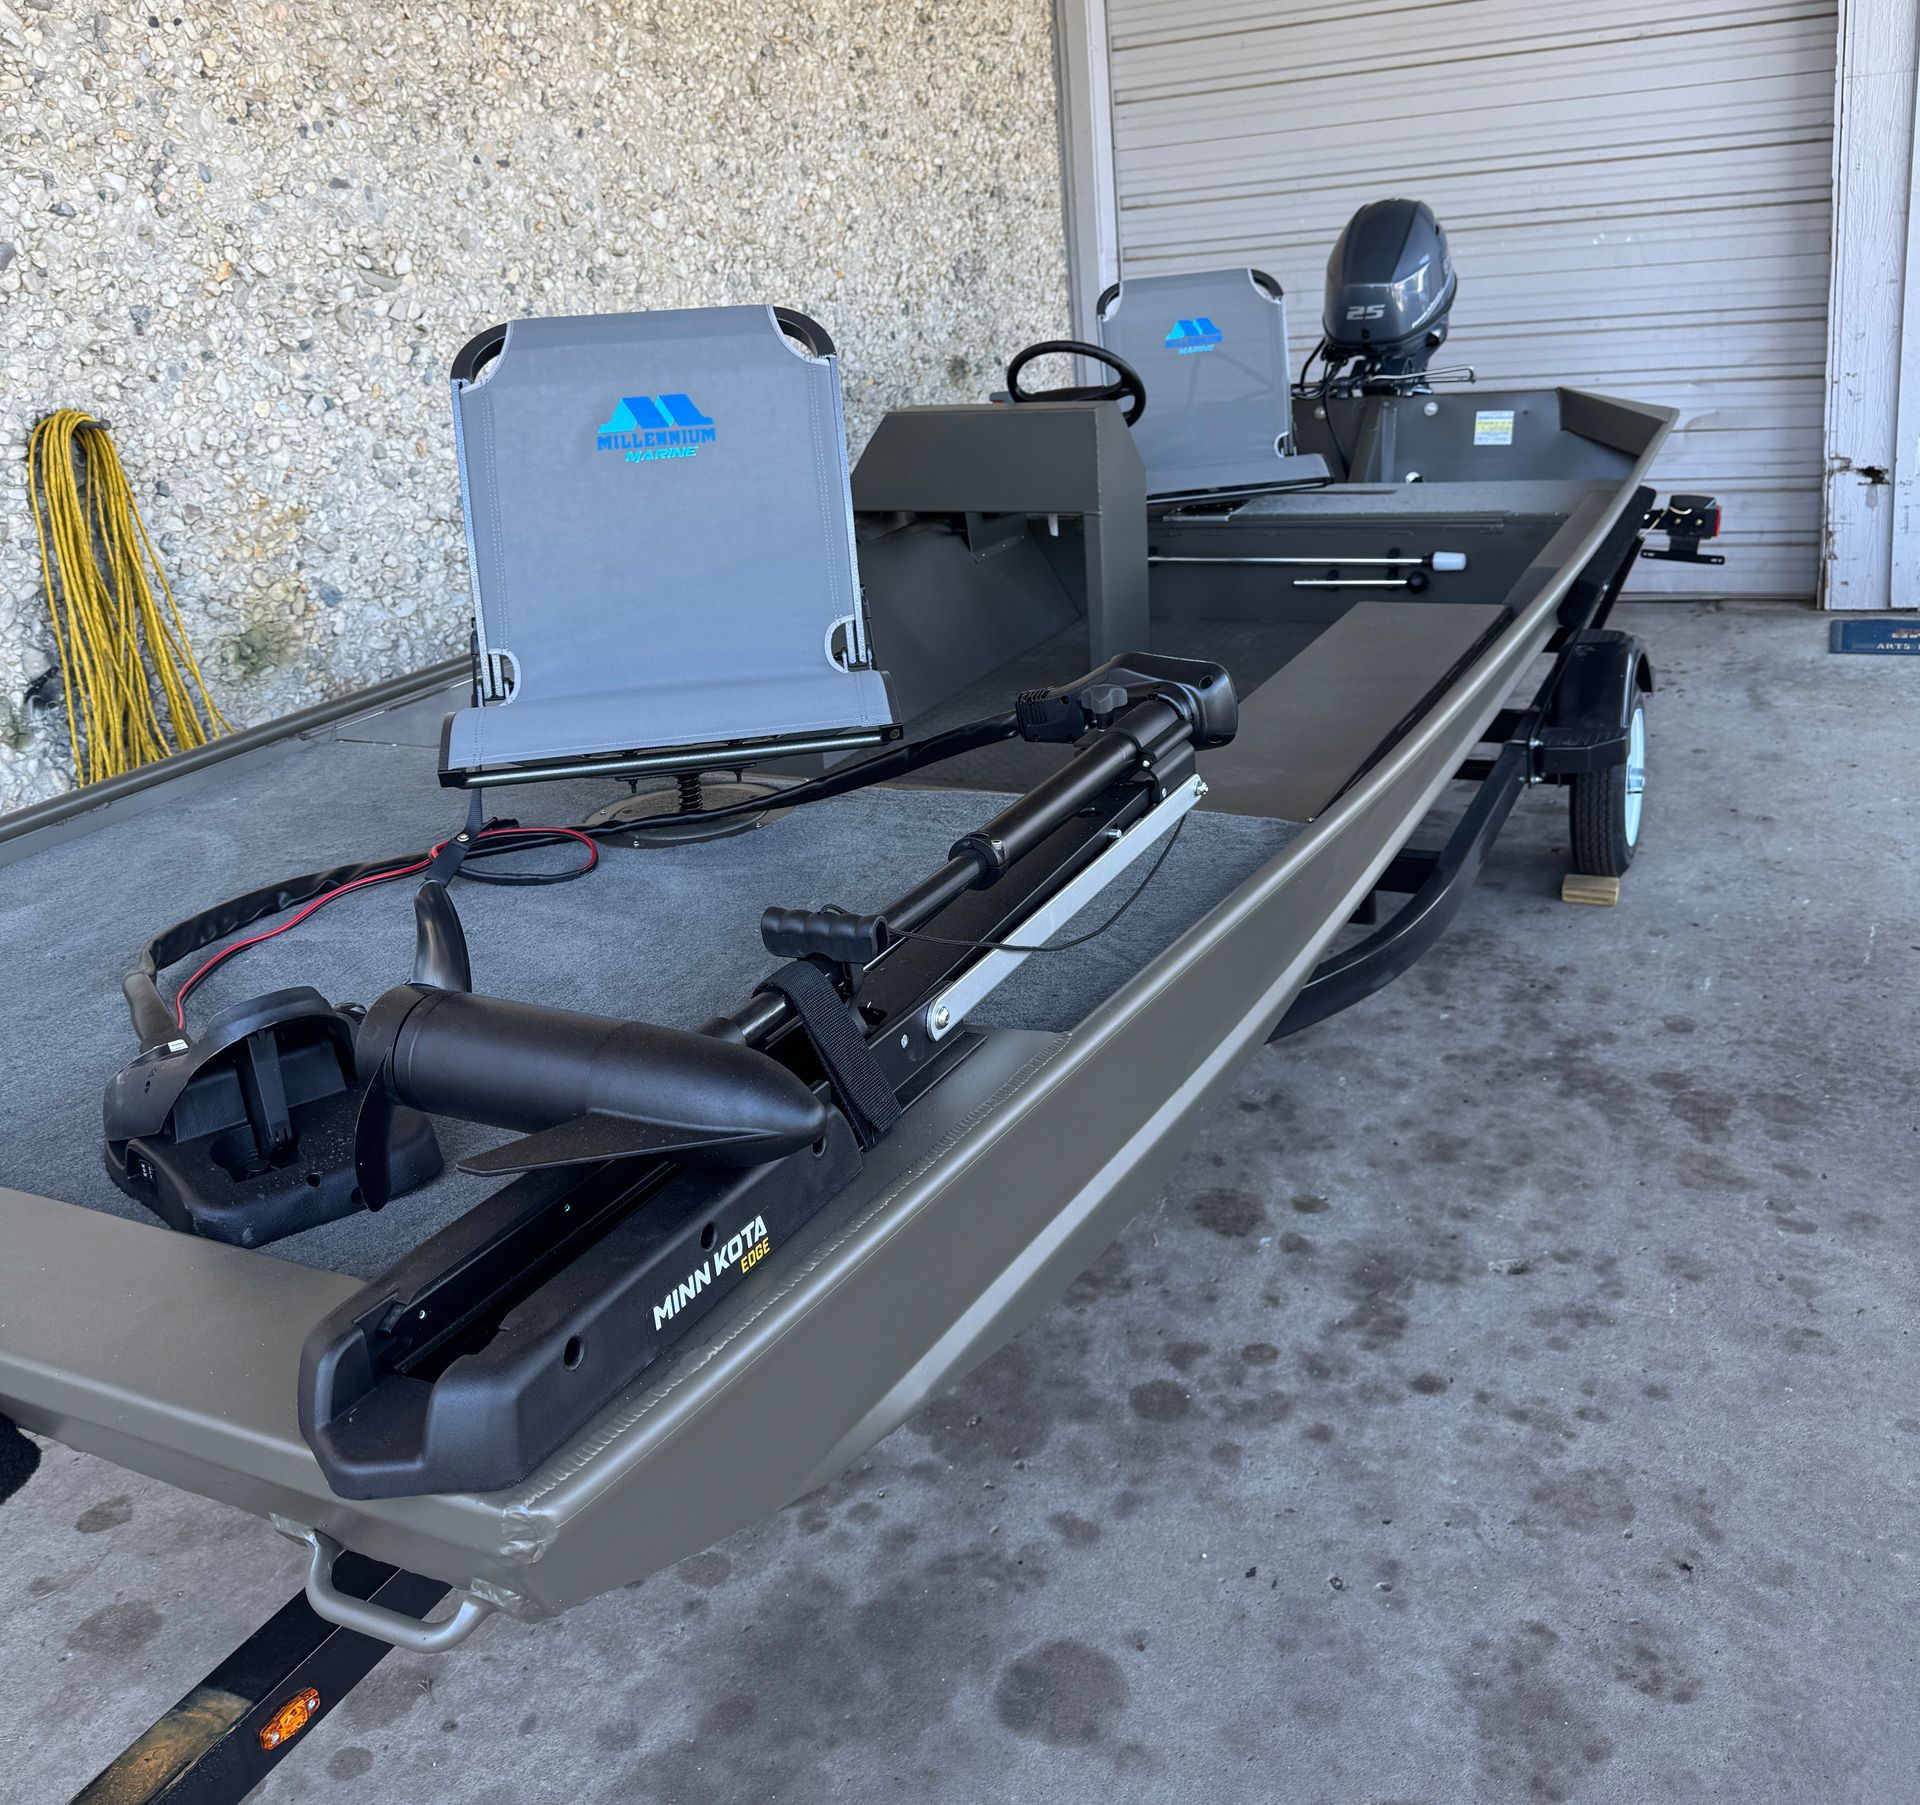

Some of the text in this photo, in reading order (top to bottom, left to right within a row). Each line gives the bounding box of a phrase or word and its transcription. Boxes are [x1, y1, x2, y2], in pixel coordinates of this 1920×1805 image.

[1346, 304, 1386, 321] 25
[596, 427, 717, 451] MILLENNIUM
[624, 445, 699, 463] MARINE
[740, 1236, 771, 1274] EDGE
[653, 1214, 768, 1332] MINN KOTA
